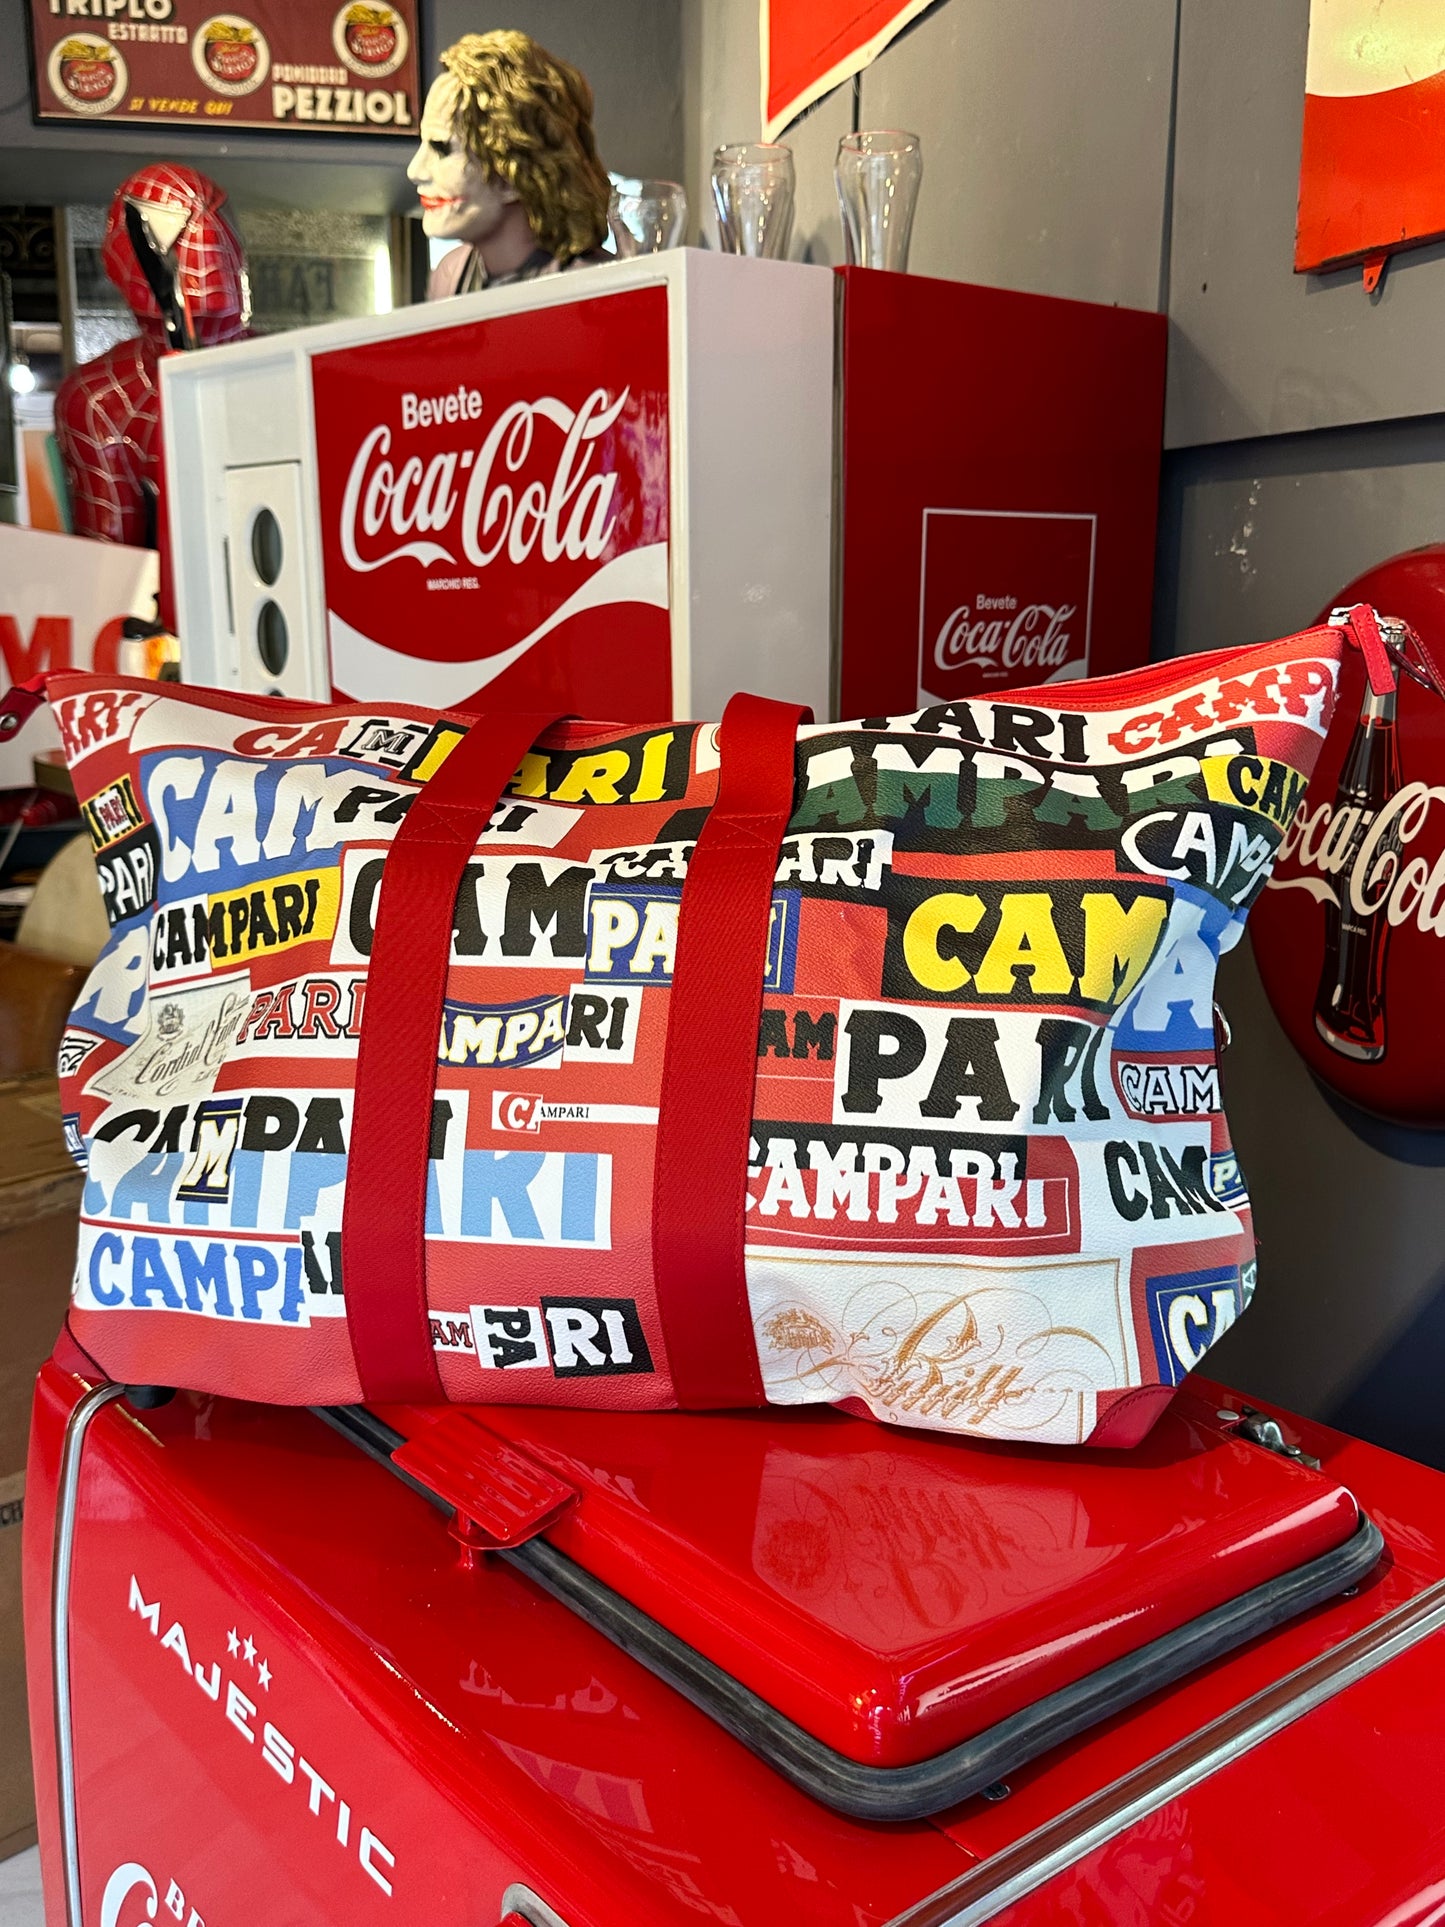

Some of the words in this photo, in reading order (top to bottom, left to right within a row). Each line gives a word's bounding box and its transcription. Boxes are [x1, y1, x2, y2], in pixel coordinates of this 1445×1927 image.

[149, 99, 199, 114] VENDE
[272, 84, 411, 125] PEZZIOL
[401, 385, 483, 430] Bevete
[340, 384, 630, 572] Coca-Cola
[976, 593, 1017, 610] Bevete
[934, 604, 1077, 671] Coca-Cola
[153, 878, 320, 971] CAMPARI
[903, 892, 1168, 1006] CAM
[1120, 1064, 1222, 1114] CAM
[1103, 1139, 1228, 1222] CAM
[128, 1572, 396, 1898] MAJESTIC
